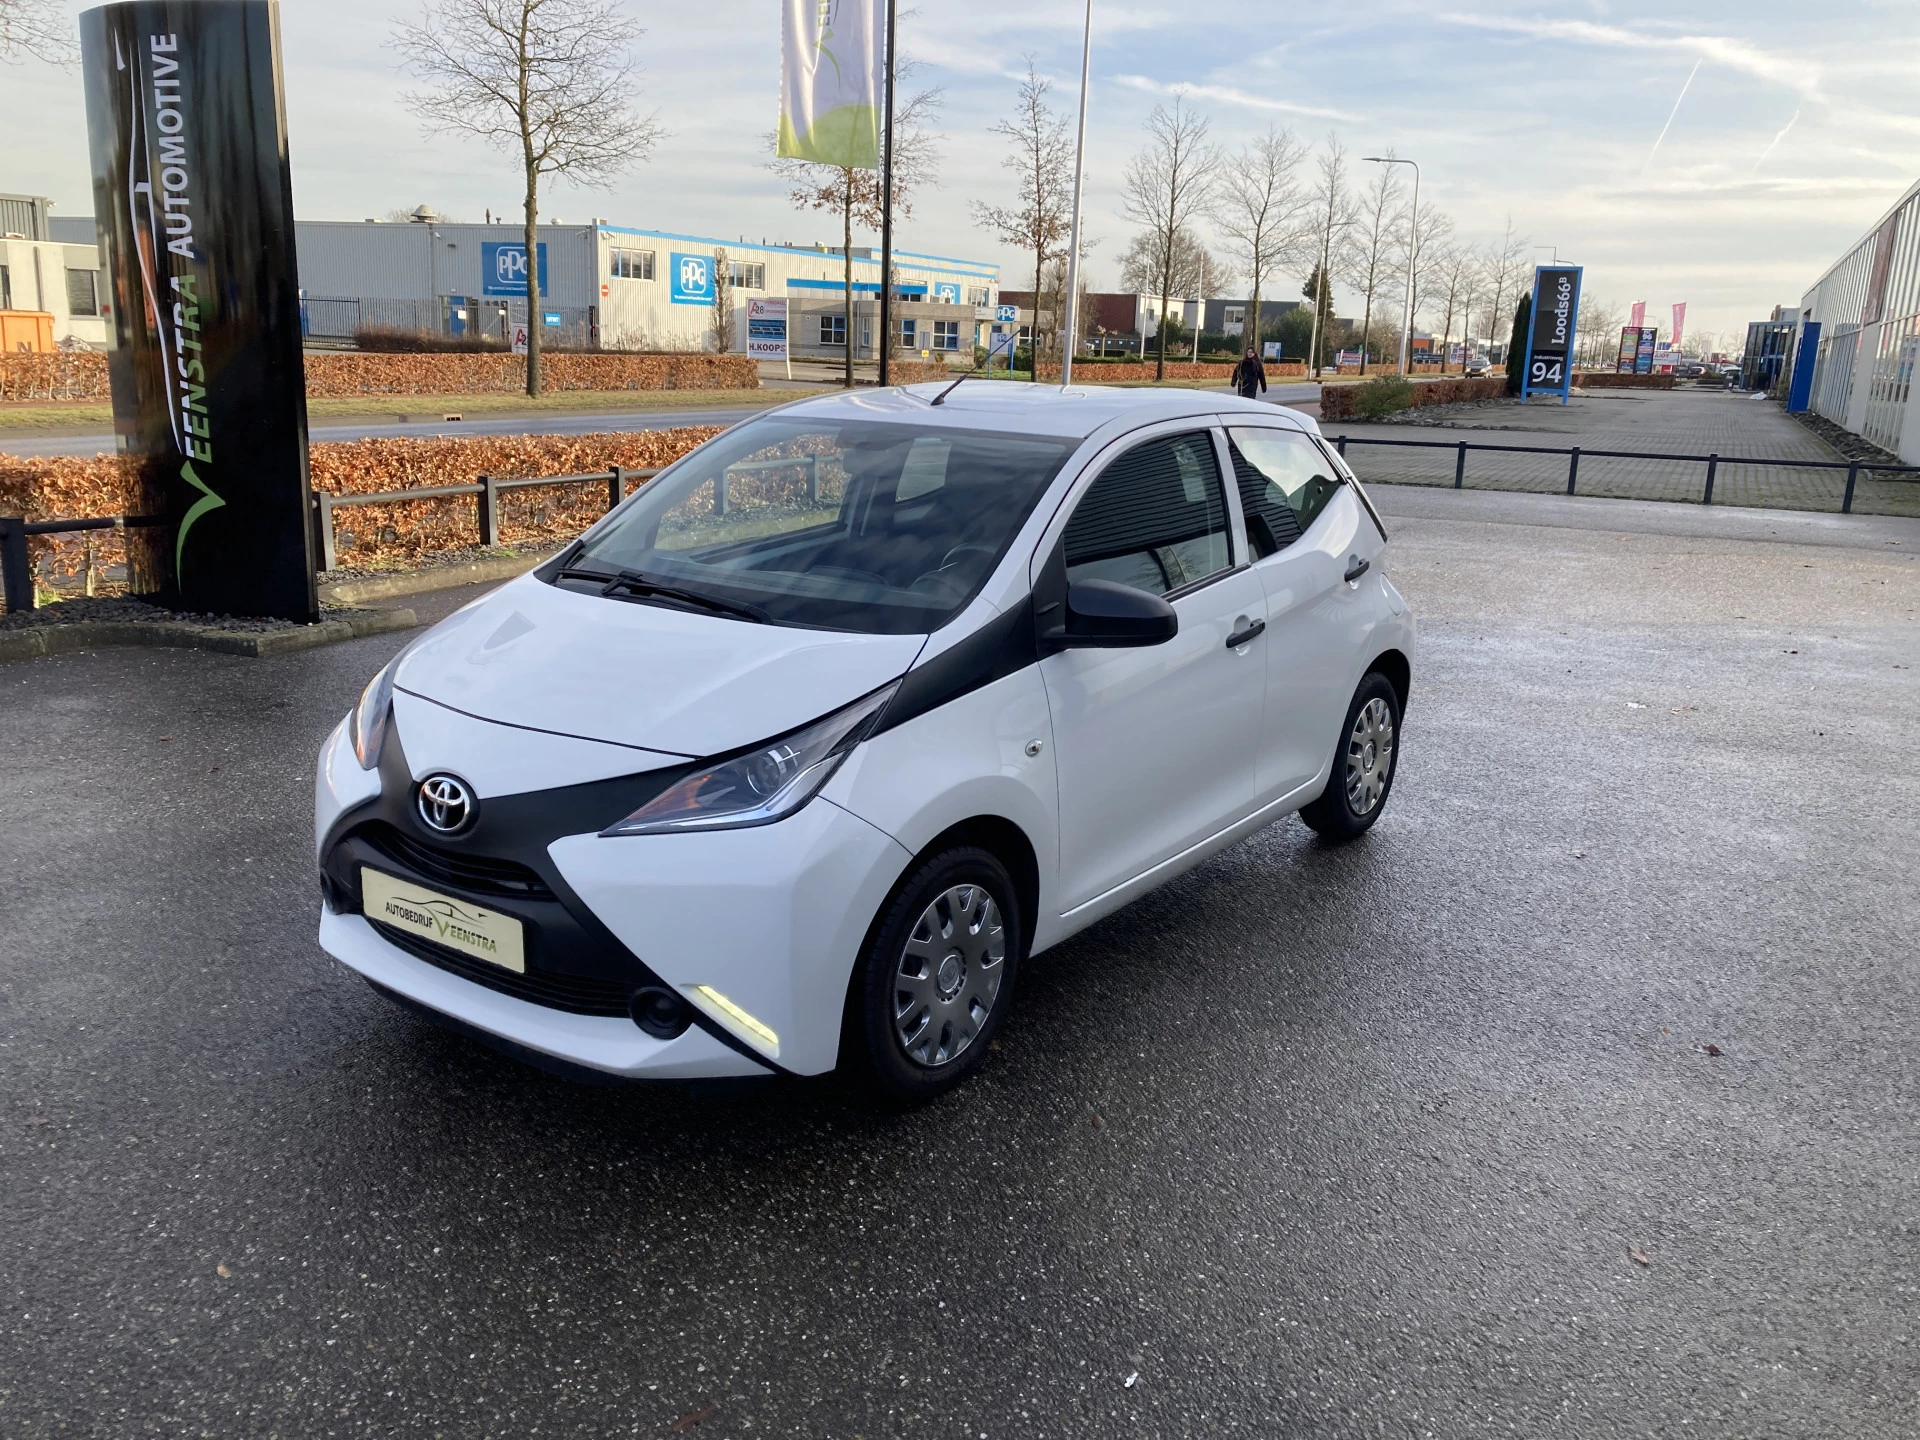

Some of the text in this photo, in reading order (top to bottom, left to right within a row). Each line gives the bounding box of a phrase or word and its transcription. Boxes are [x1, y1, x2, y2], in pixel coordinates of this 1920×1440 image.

[682, 262, 704, 289] PPG
[150, 33, 226, 594] VEENSTRA AUTOMOTIVE
[750, 301, 765, 315] A28
[997, 306, 1015, 321] PPG
[748, 343, 786, 352] H.KOOPS
[1532, 362, 1562, 383] 94
[385, 901, 497, 953] AUTOBEDRIJF VEENSTRA
